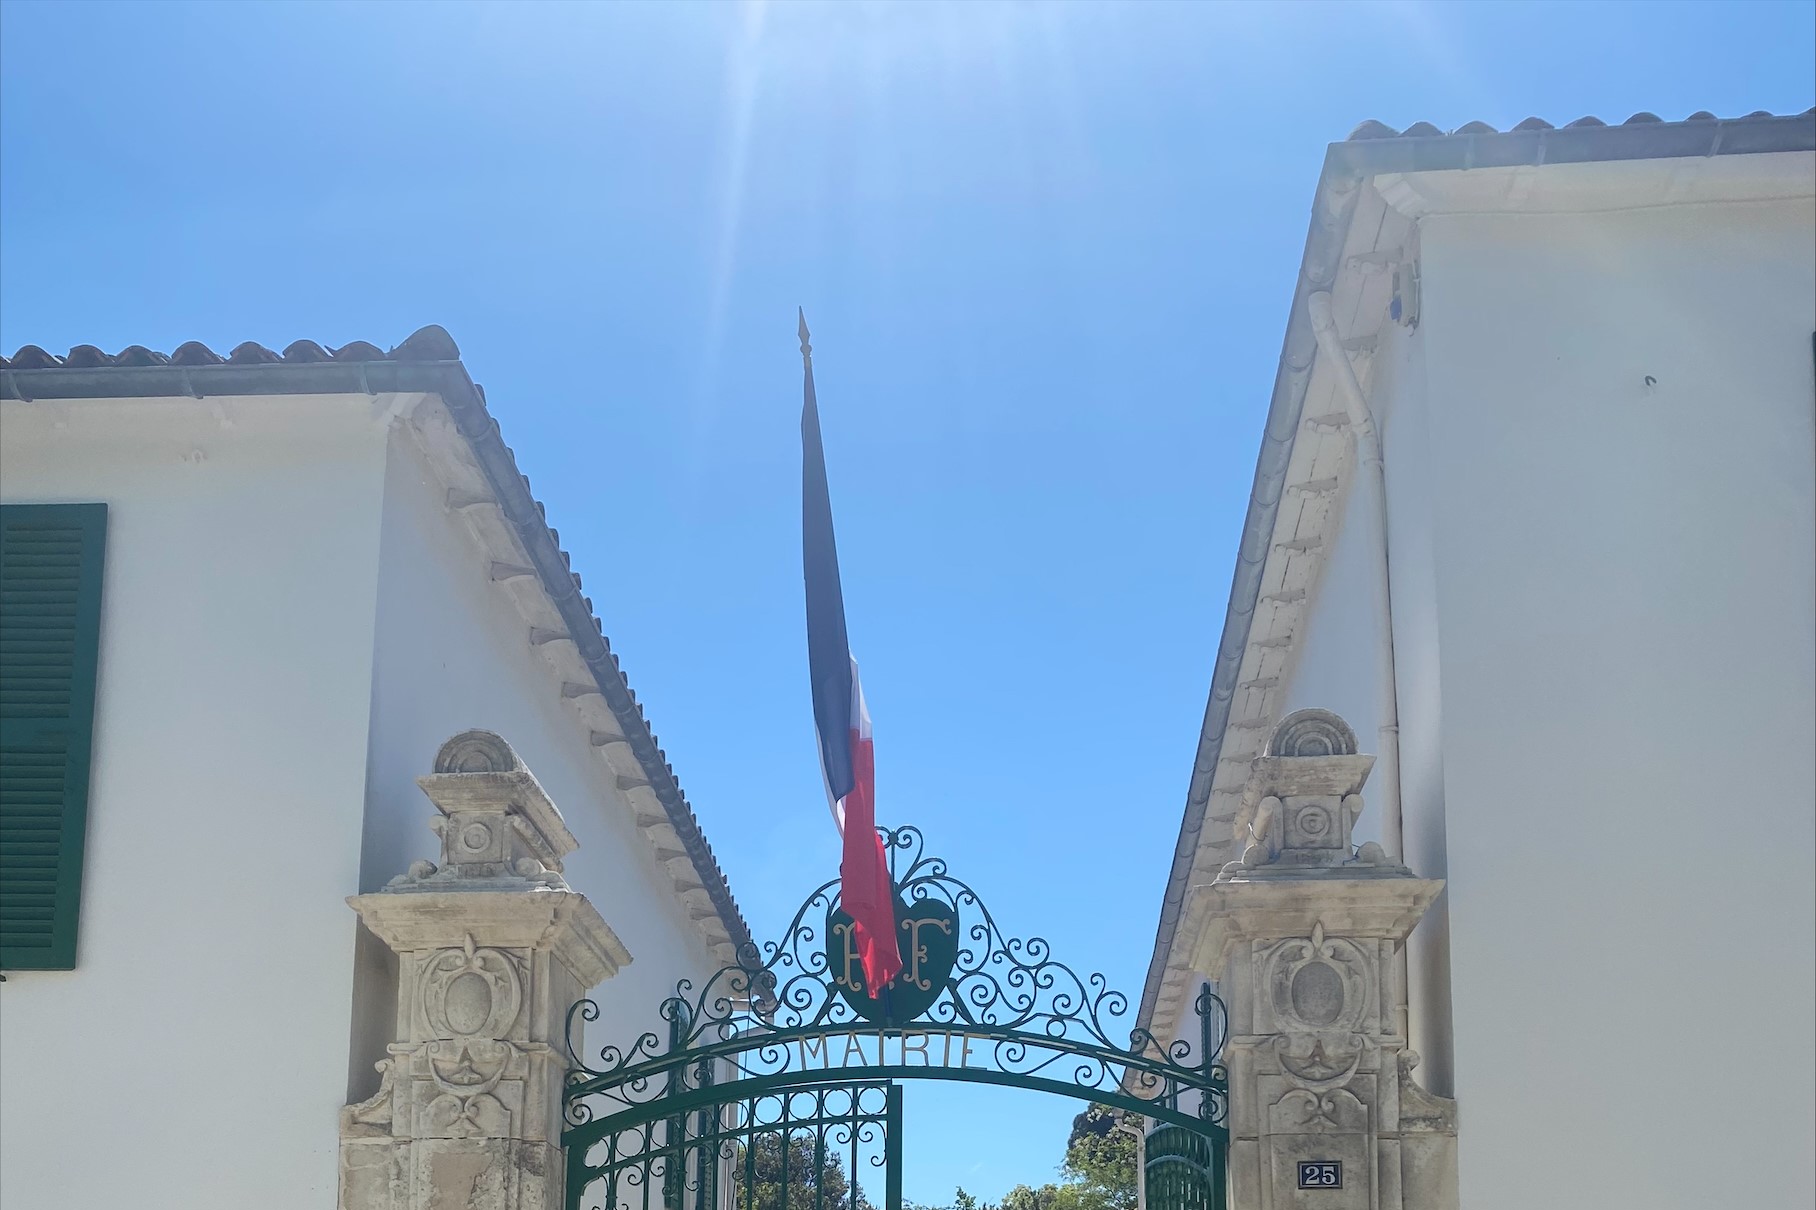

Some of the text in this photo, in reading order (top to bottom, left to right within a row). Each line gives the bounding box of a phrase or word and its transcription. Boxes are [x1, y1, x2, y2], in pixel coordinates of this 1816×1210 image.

[901, 918, 952, 991] F
[799, 1029, 991, 1070] MAIRIE
[1305, 1166, 1336, 1185] 25
